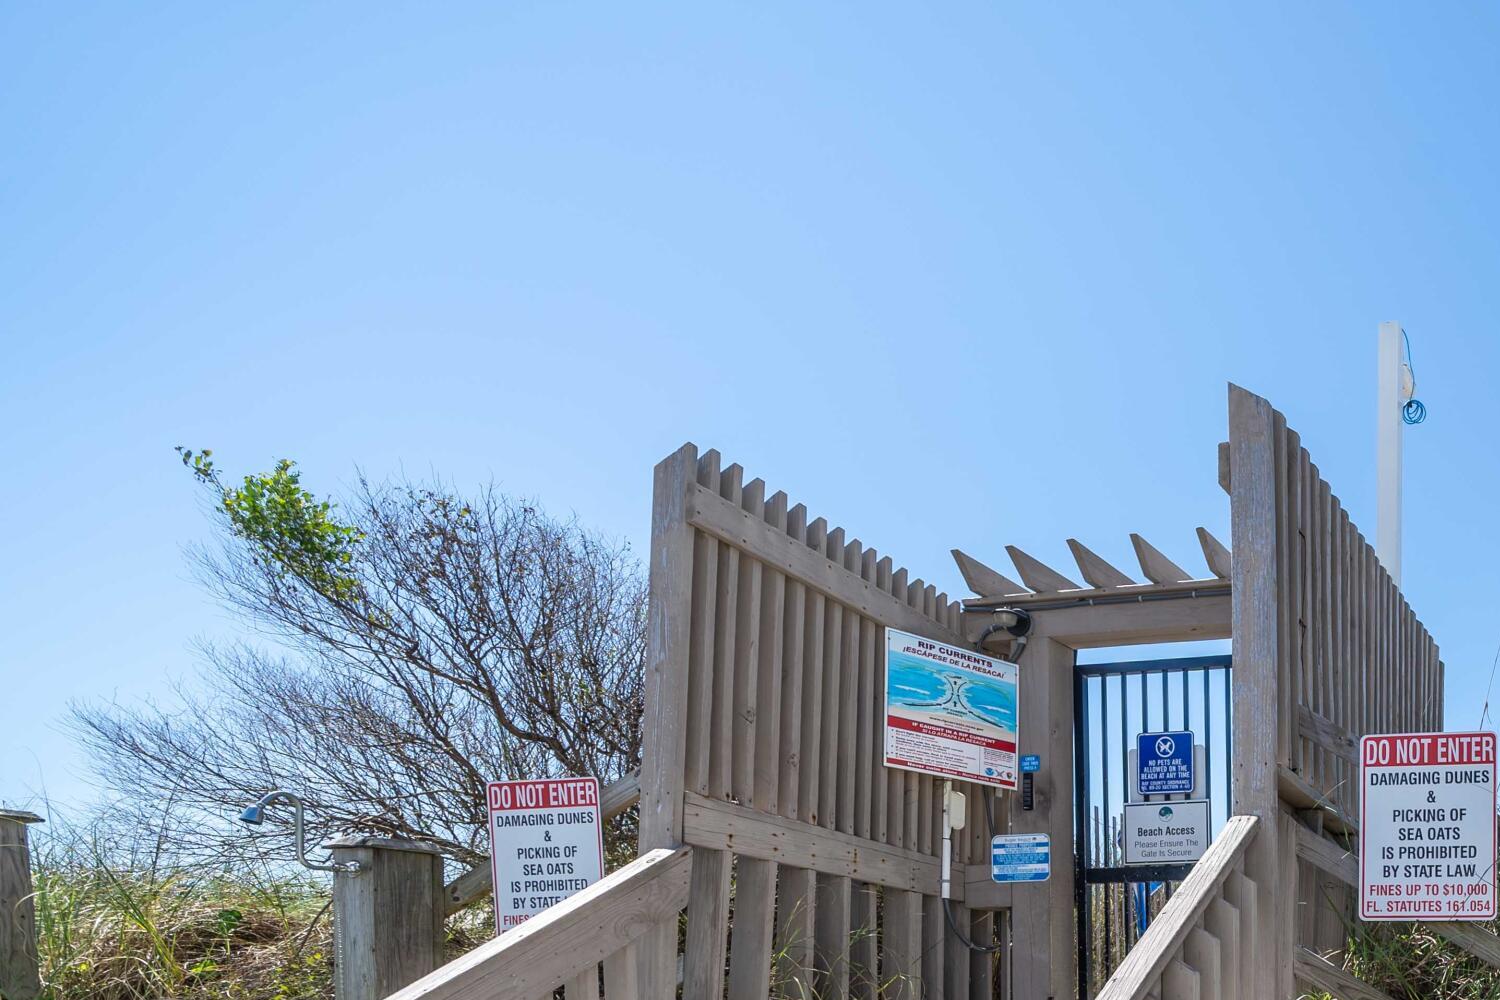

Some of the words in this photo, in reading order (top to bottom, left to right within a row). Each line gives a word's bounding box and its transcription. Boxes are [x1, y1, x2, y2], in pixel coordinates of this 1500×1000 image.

[918, 640, 936, 651] RIP
[938, 646, 993, 668] CURRENTS
[949, 658, 960, 666] DE
[961, 661, 971, 670] LA
[971, 665, 1005, 679] RESACA!
[919, 722, 945, 732] CAUGHT
[969, 734, 996, 744] CURRENT
[1365, 739, 1390, 765] DO
[1396, 737, 1431, 764] NOT
[1437, 736, 1494, 764] ENTER
[1143, 765, 1168, 773] ALLOWED
[1177, 764, 1188, 772] THE
[1148, 759, 1156, 767] NO
[1370, 771, 1440, 786] DAMAGING
[1445, 769, 1489, 784] DUNES
[490, 786, 511, 809] DO
[515, 783, 545, 808] NOT
[548, 781, 596, 806] ENTER
[1426, 790, 1436, 803] &
[496, 813, 554, 828] DAMAGING
[558, 811, 594, 825] DUNES
[1392, 808, 1445, 823] PICKING
[1450, 808, 1467, 821] OF
[544, 830, 552, 842] &
[1137, 827, 1163, 837] Beach
[1165, 826, 1195, 836] Access
[1398, 827, 1426, 841] SEA
[1427, 826, 1460, 840] OATS
[1134, 840, 1158, 849] Please
[1160, 839, 1183, 848] Ensure
[1186, 838, 1199, 847] The
[517, 846, 561, 859] PICKING
[563, 845, 578, 858] OF
[1141, 850, 1157, 858] Gate
[1167, 848, 1192, 857] Secure
[1382, 846, 1394, 860] IS
[1399, 845, 1477, 859] PROHIBITED
[523, 863, 544, 876] SEA
[547, 862, 574, 875] OATS
[1383, 864, 1399, 878] BY
[1404, 864, 1442, 878] STATE
[1447, 864, 1476, 877] LAW
[511, 881, 521, 893] IS
[524, 878, 588, 893] PROHIBITED
[1369, 884, 1402, 896] FINES
[1406, 884, 1421, 896] UP
[1426, 884, 1439, 896] TO
[1442, 883, 1488, 897] $10,000
[513, 897, 525, 910] BY
[1366, 901, 1382, 913] FL.
[1387, 900, 1442, 913] STATUTES
[1446, 899, 1490, 912] 161.054
